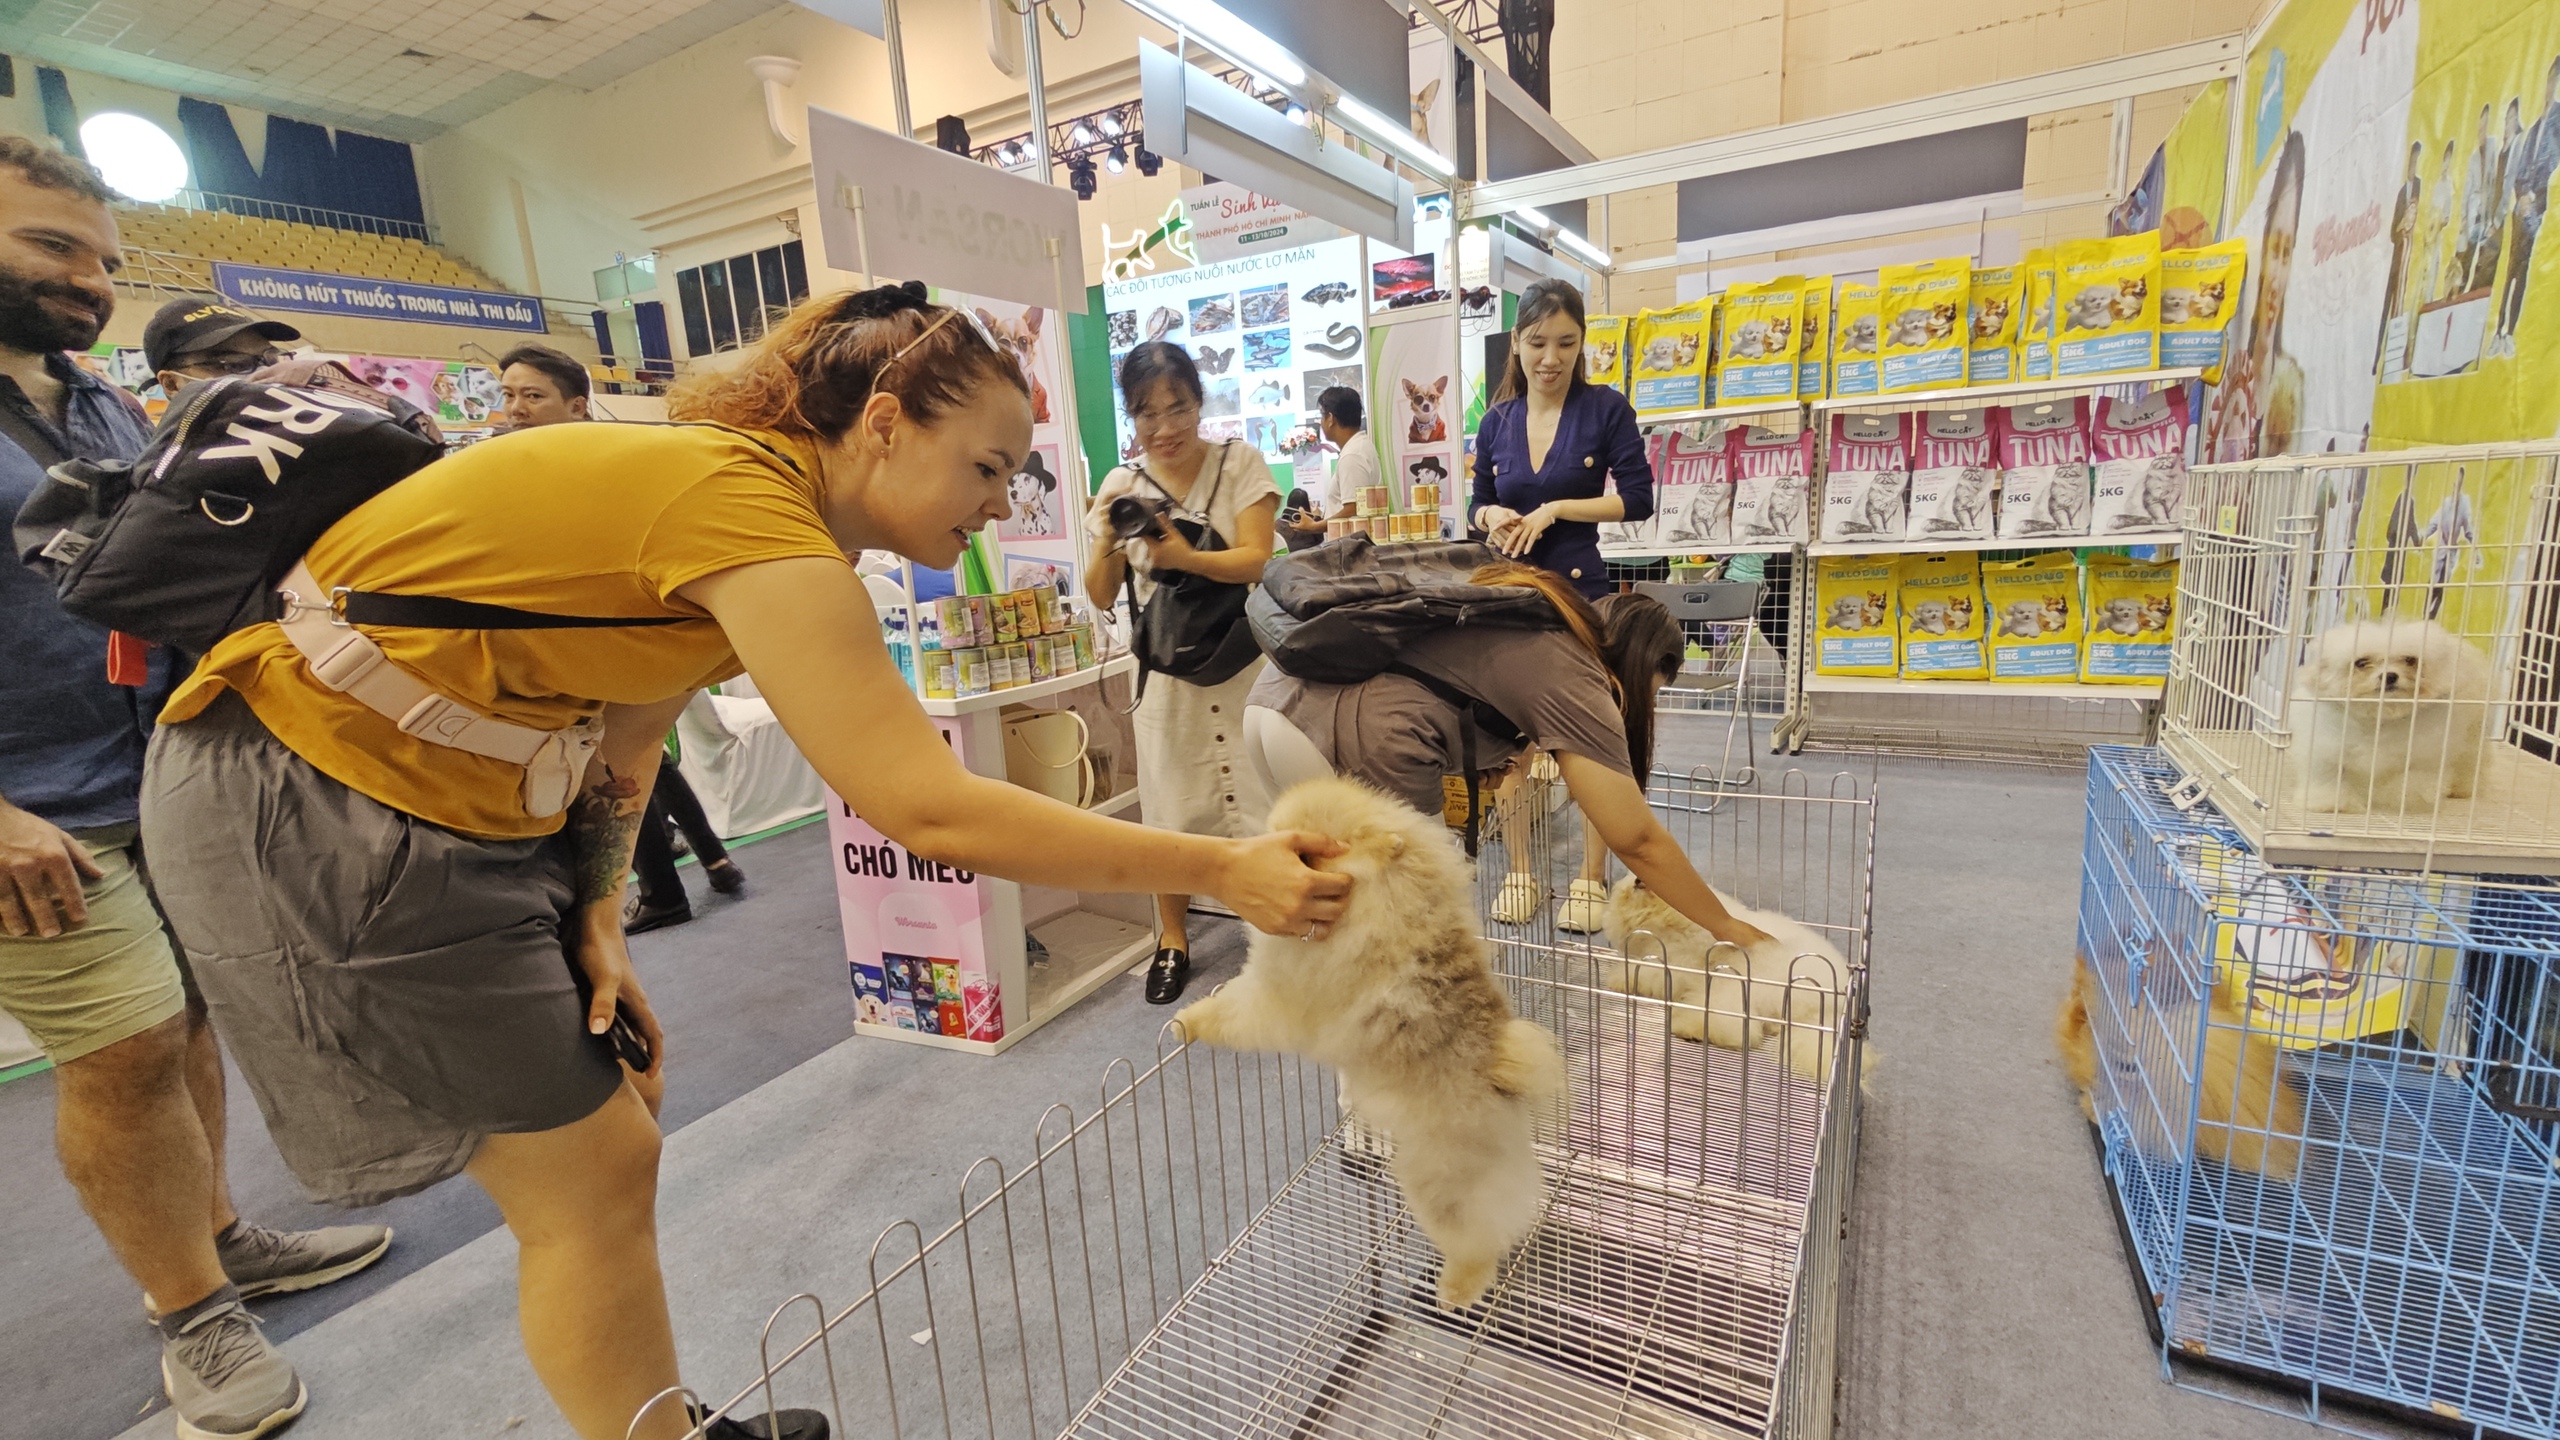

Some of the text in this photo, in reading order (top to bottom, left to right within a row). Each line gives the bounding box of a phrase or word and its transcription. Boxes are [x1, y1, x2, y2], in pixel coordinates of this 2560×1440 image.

[1221, 191, 1257, 219] Sinh
[1270, 214, 1291, 225] MINH
[1252, 228, 1284, 241] 13/10/2024
[1194, 264, 1224, 280] NUÔI
[1227, 256, 1263, 275] NƯỚC
[2161, 259, 2192, 268] ELLO
[239, 277, 533, 323] KHÔNG HÚT THUỐC TRONG NHÀ THI ĐẤU
[1734, 294, 1766, 305] HELLO
[2098, 337, 2147, 350] ADULT DOG
[2171, 336, 2221, 345] ADULT DOG
[2062, 348, 2085, 358] 5KG
[1752, 368, 1789, 378] ADULT DOG
[1802, 367, 1818, 375] DOG
[1840, 369, 1859, 377] 5KG
[1725, 372, 1743, 382] 5KG
[2101, 423, 2182, 460] TUNA
[1923, 439, 1990, 469] TUNA
[2009, 432, 2087, 467] TUNA
[1838, 443, 1905, 471] TUNA
[1740, 450, 1804, 479] TUNA
[1671, 457, 1727, 484] TUNA
[2099, 486, 2124, 497] 5KG
[1830, 496, 1852, 504] 5KG
[1915, 493, 1937, 503] 5KG
[2007, 493, 2031, 504] 5KG
[1737, 501, 1755, 509] 5KG
[1662, 507, 1678, 515] 5KG
[1828, 570, 1860, 579] HELLO
[1995, 574, 2032, 584] HELLO
[2099, 570, 2137, 579] HELLO
[1904, 577, 1939, 586] HELLO
[1998, 652, 2018, 661] 5KG
[2030, 649, 2054, 657] ADULT
[2092, 649, 2115, 657] 5KG
[843, 839, 898, 879] CHÓ
